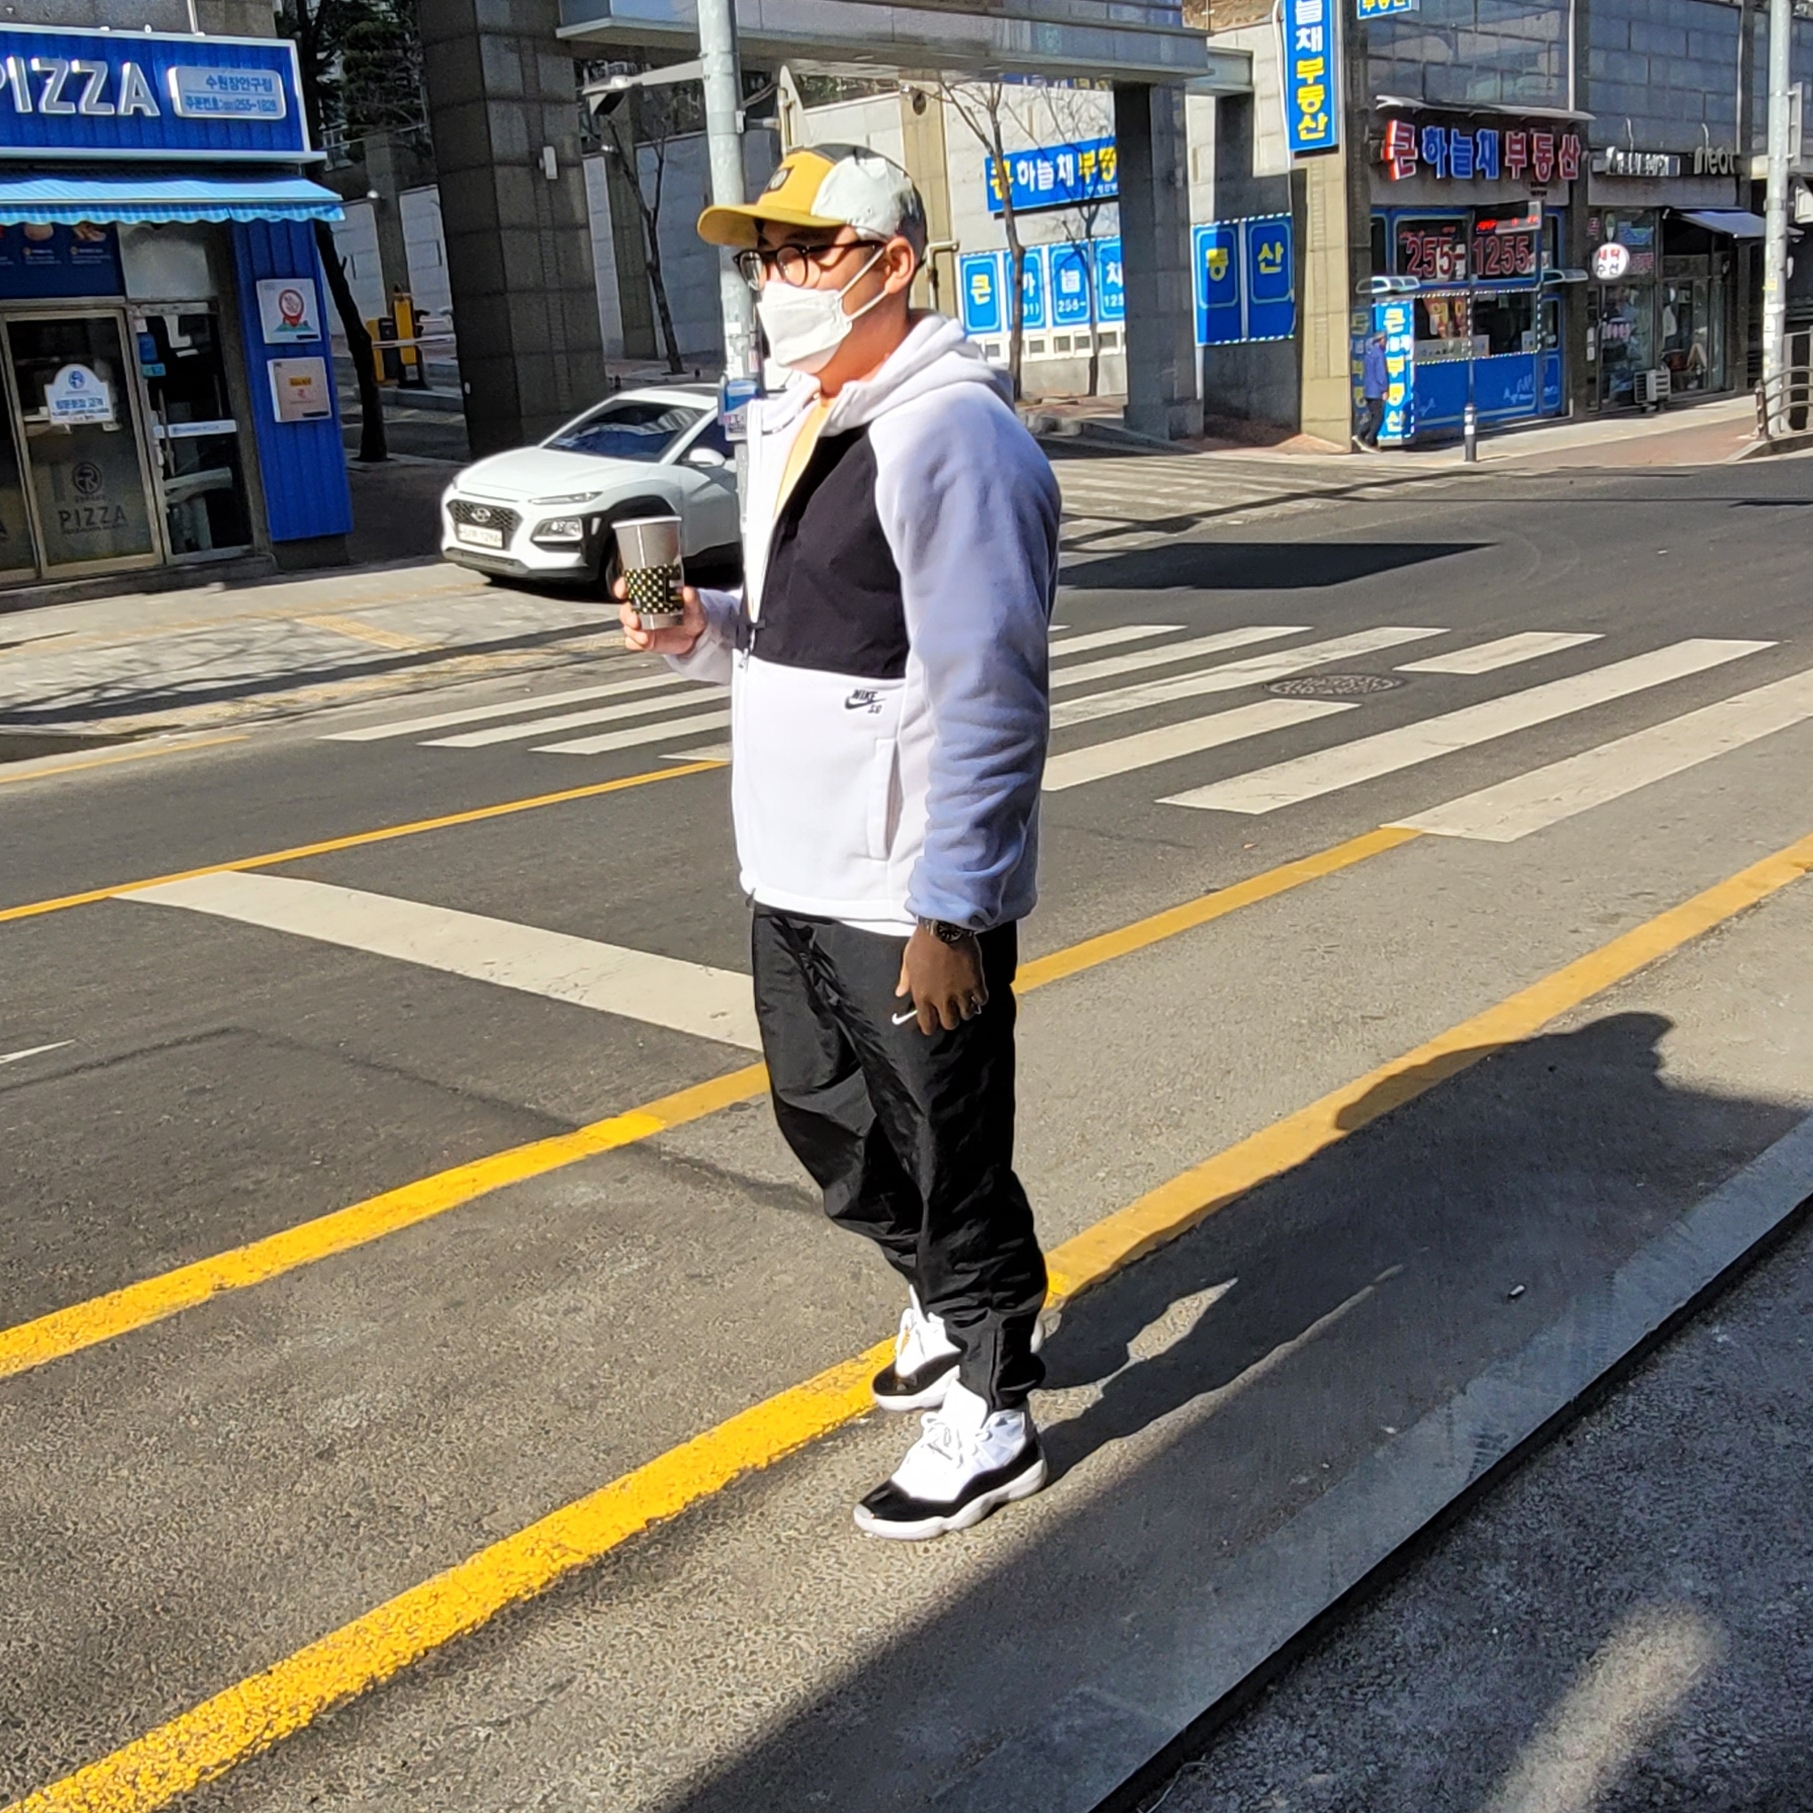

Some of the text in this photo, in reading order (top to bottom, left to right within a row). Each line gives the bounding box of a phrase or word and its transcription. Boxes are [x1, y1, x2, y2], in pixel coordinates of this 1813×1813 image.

[1257, 242, 1285, 274] 산
[58, 505, 128, 530] PIZZA
[852, 690, 878, 701] NIKE
